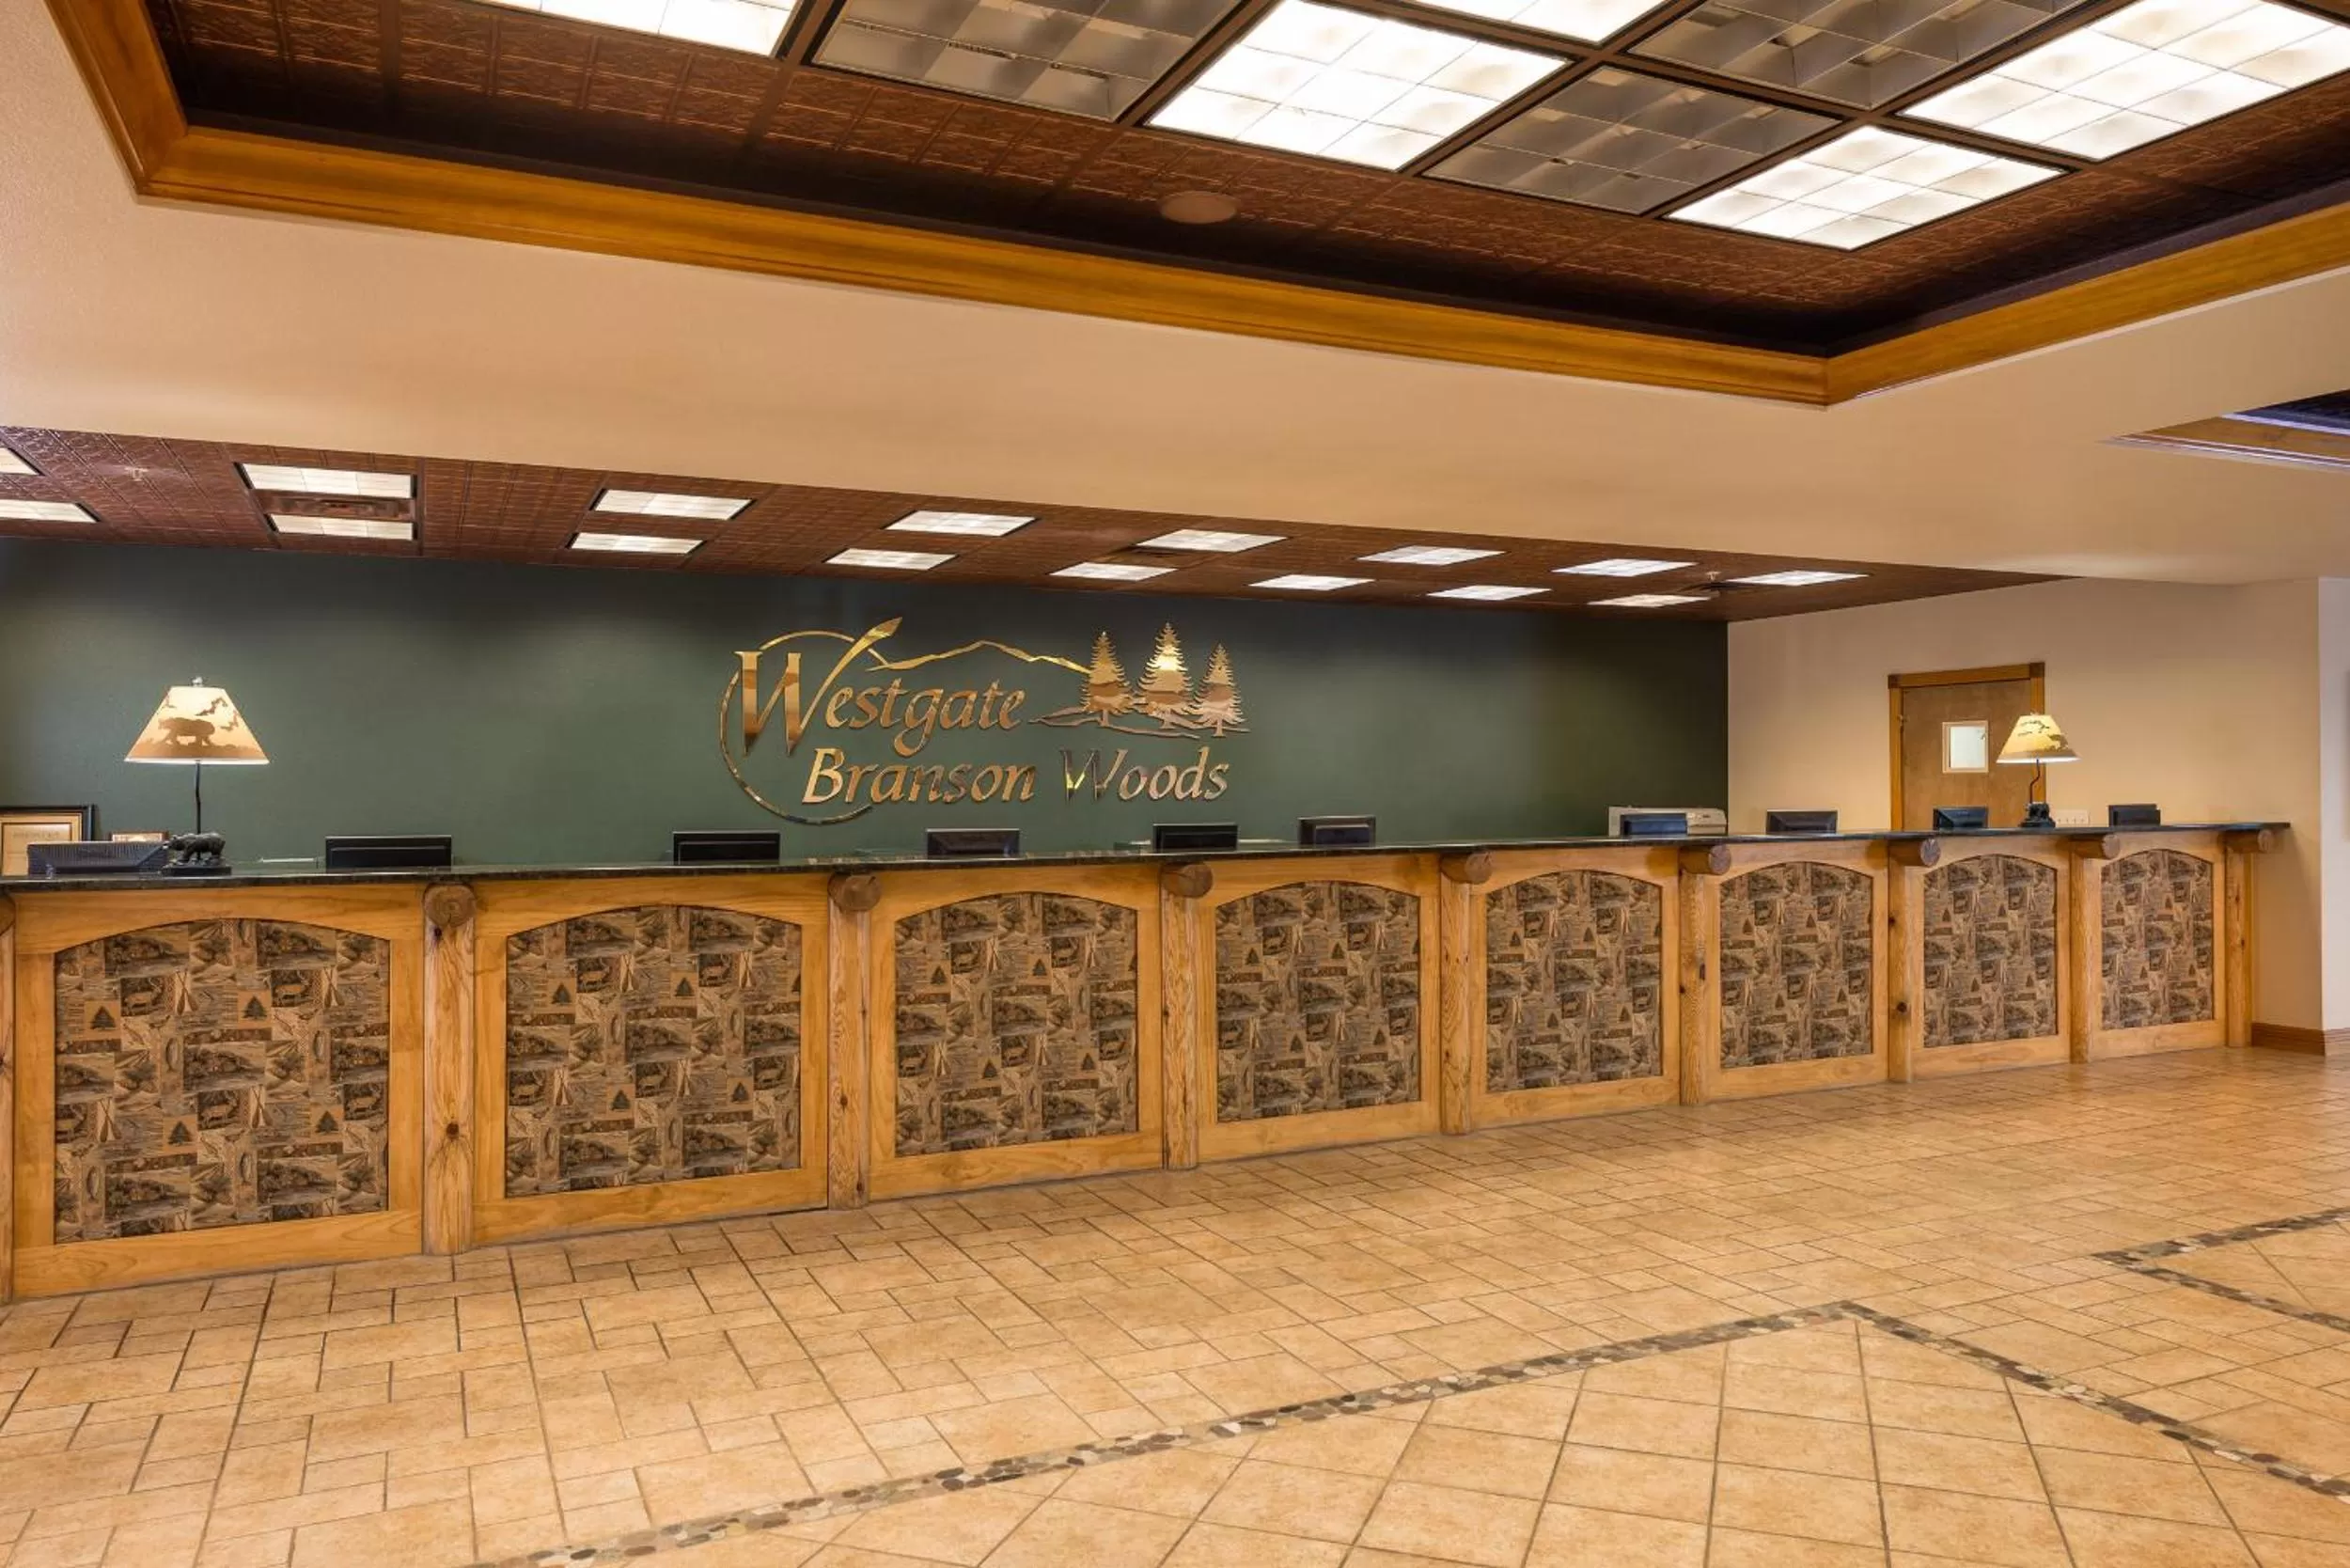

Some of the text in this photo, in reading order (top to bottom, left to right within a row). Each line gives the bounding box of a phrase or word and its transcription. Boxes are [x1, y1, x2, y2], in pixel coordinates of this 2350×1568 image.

[733, 617, 1027, 758] Westgate
[801, 745, 1230, 805] Branson Woods
